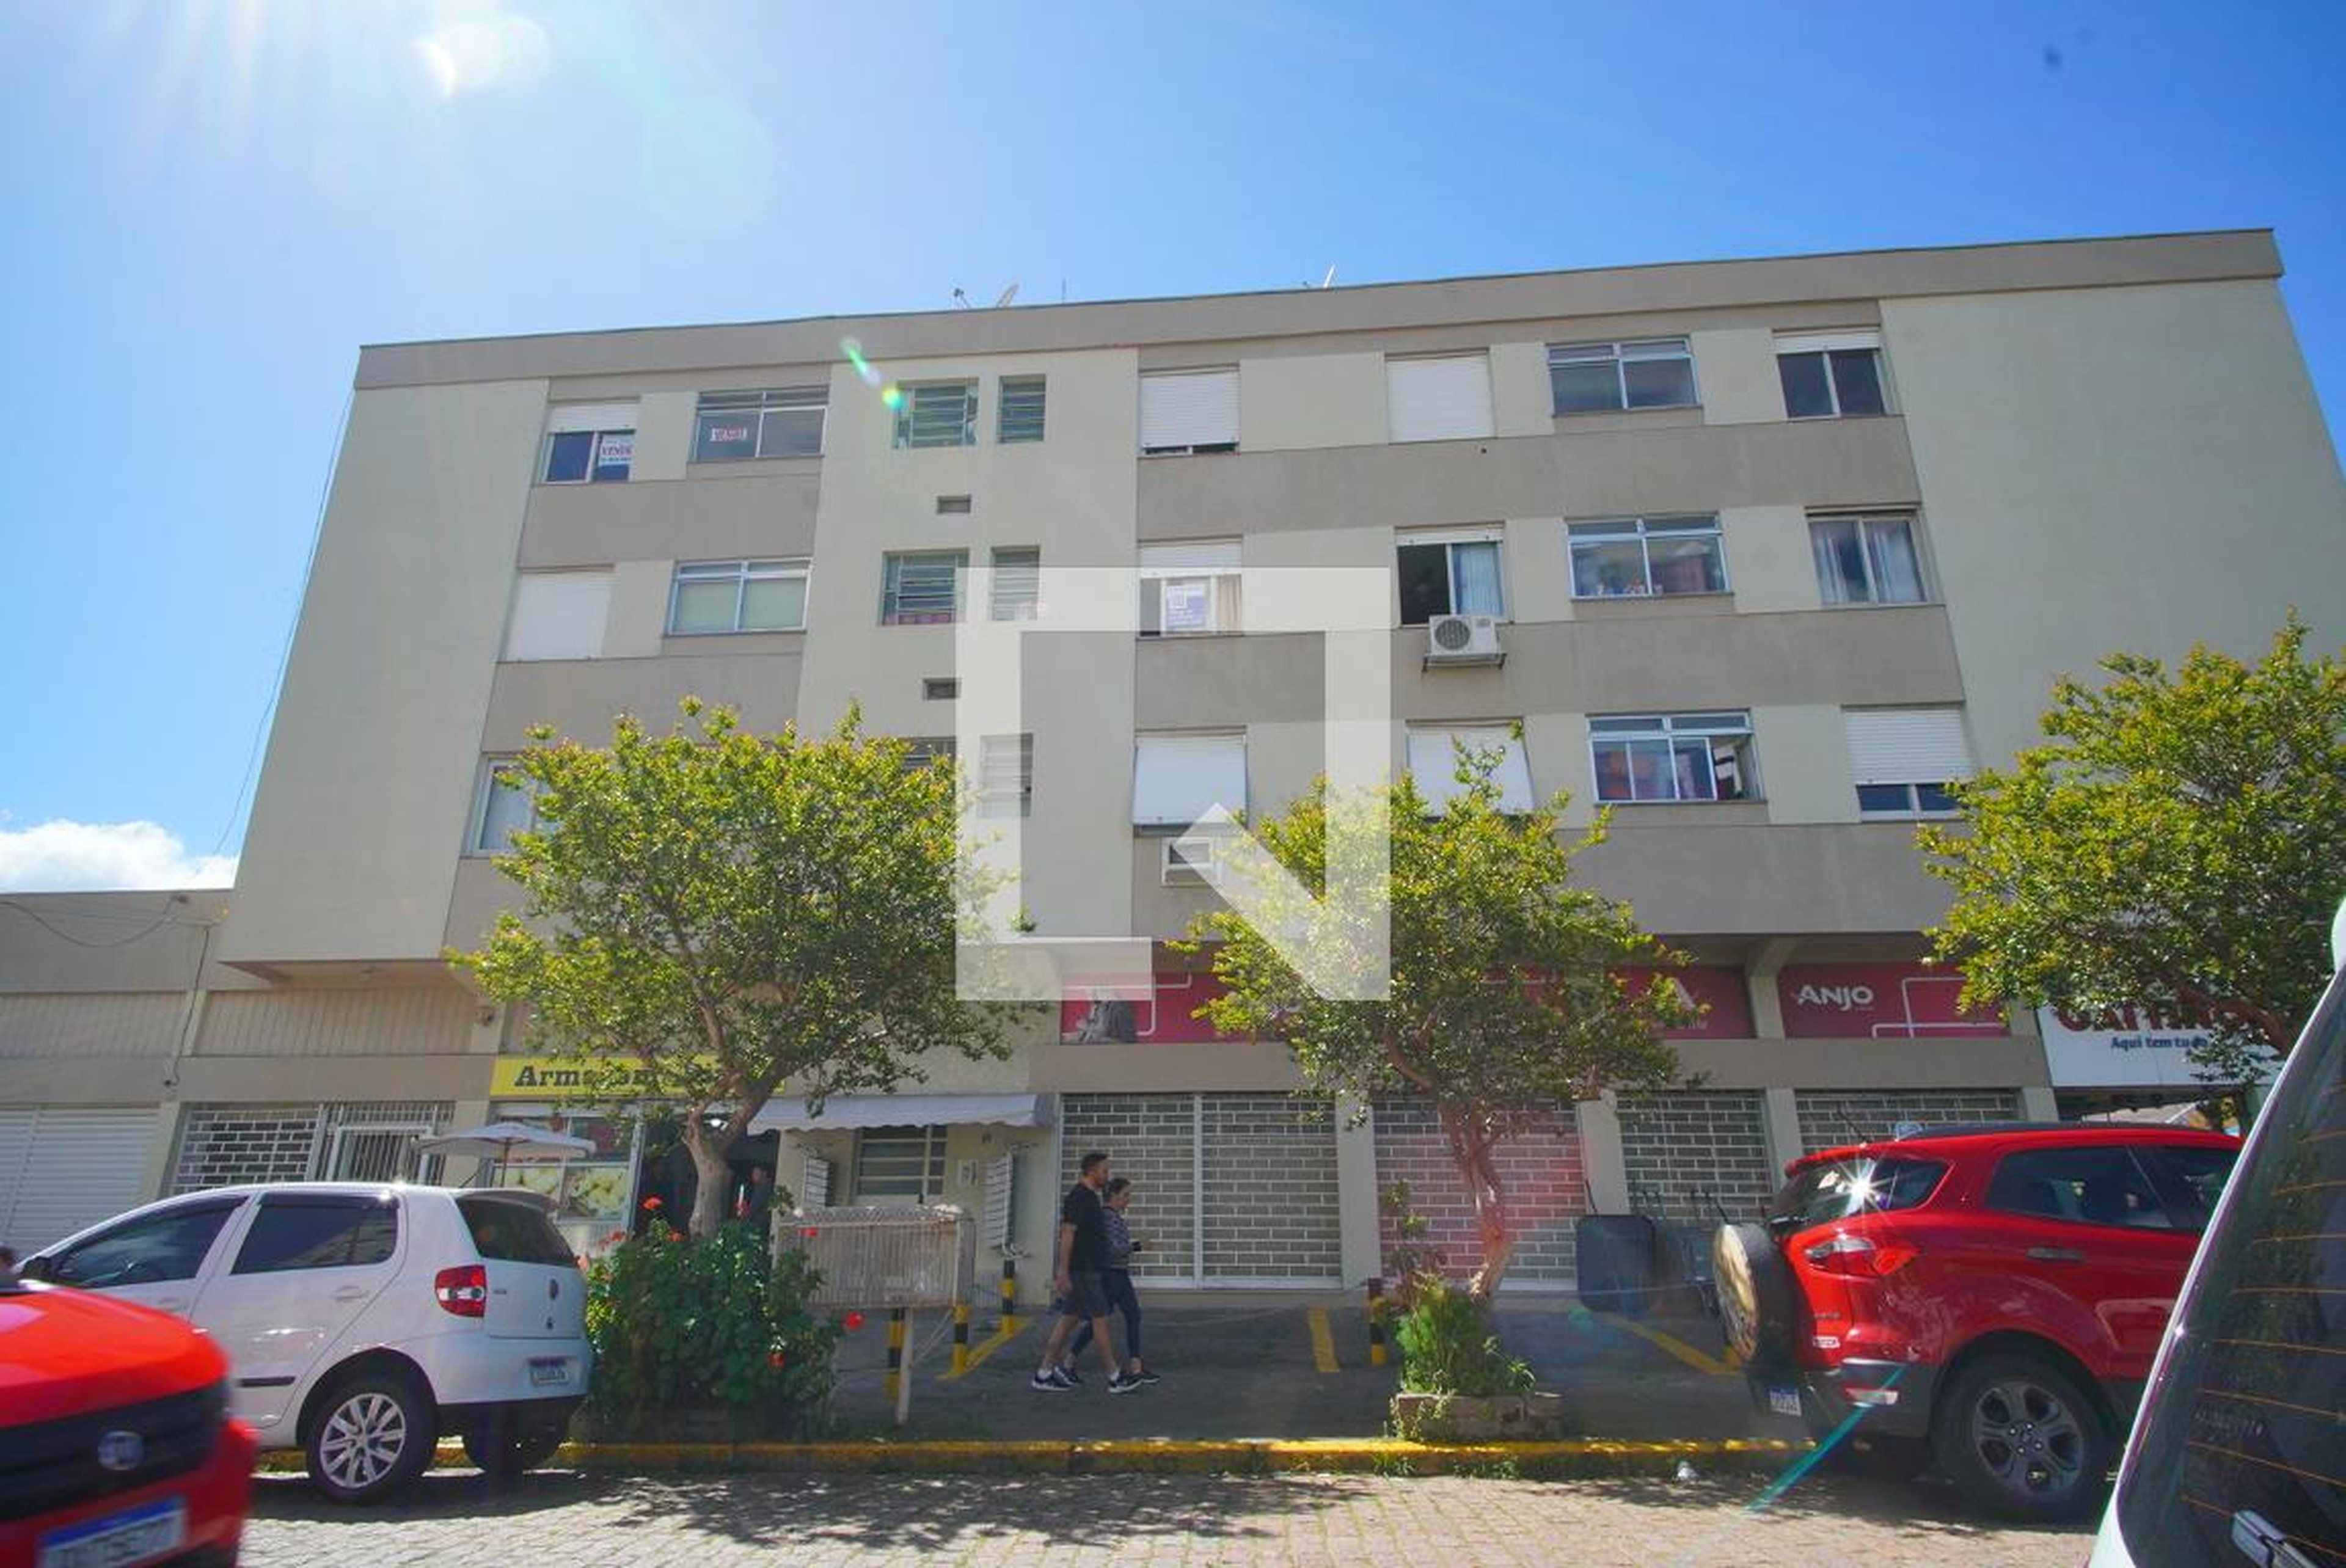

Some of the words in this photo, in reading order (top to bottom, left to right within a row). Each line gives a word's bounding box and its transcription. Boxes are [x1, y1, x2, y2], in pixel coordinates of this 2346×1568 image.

[1797, 985, 1874, 1012] ANJO
[2111, 1036, 2142, 1051] Aqui
[2146, 1037, 2172, 1048] tem
